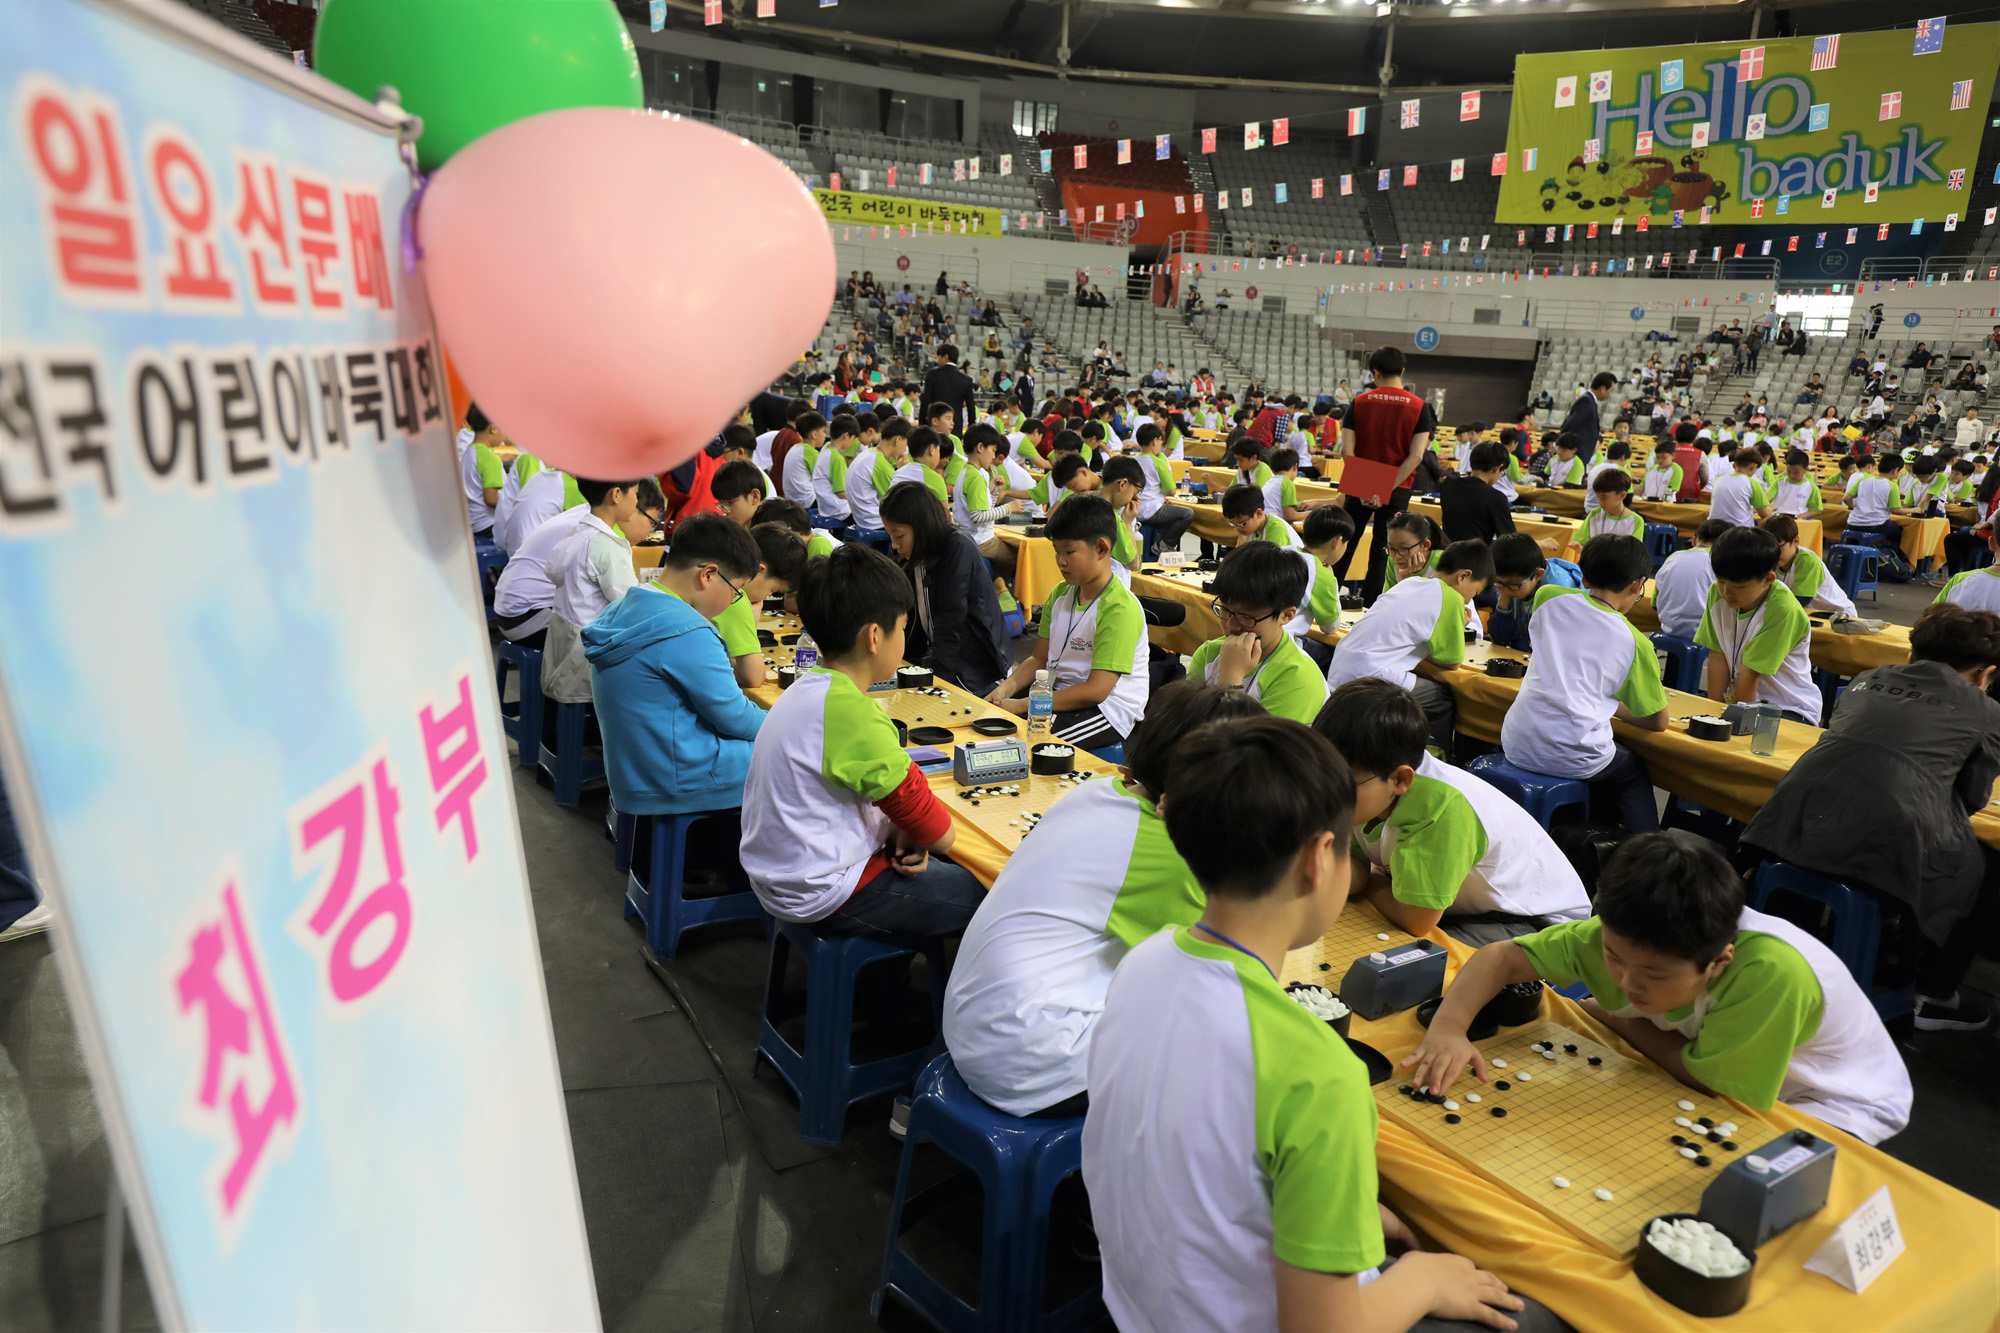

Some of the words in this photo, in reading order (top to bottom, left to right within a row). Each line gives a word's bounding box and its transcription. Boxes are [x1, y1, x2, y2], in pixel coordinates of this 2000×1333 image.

[1591, 60, 1812, 155] Hello
[1739, 127, 1944, 202] baduk
[30, 94, 394, 311] 일요신문배
[820, 193, 854, 214] 전국
[861, 200, 912, 219] 어린이
[920, 206, 985, 226] 바둑대회
[1826, 255, 1843, 266] E2
[1420, 331, 1434, 343] E1
[0, 357, 116, 516] 전국
[1855, 1215, 1895, 1272] 최강부
